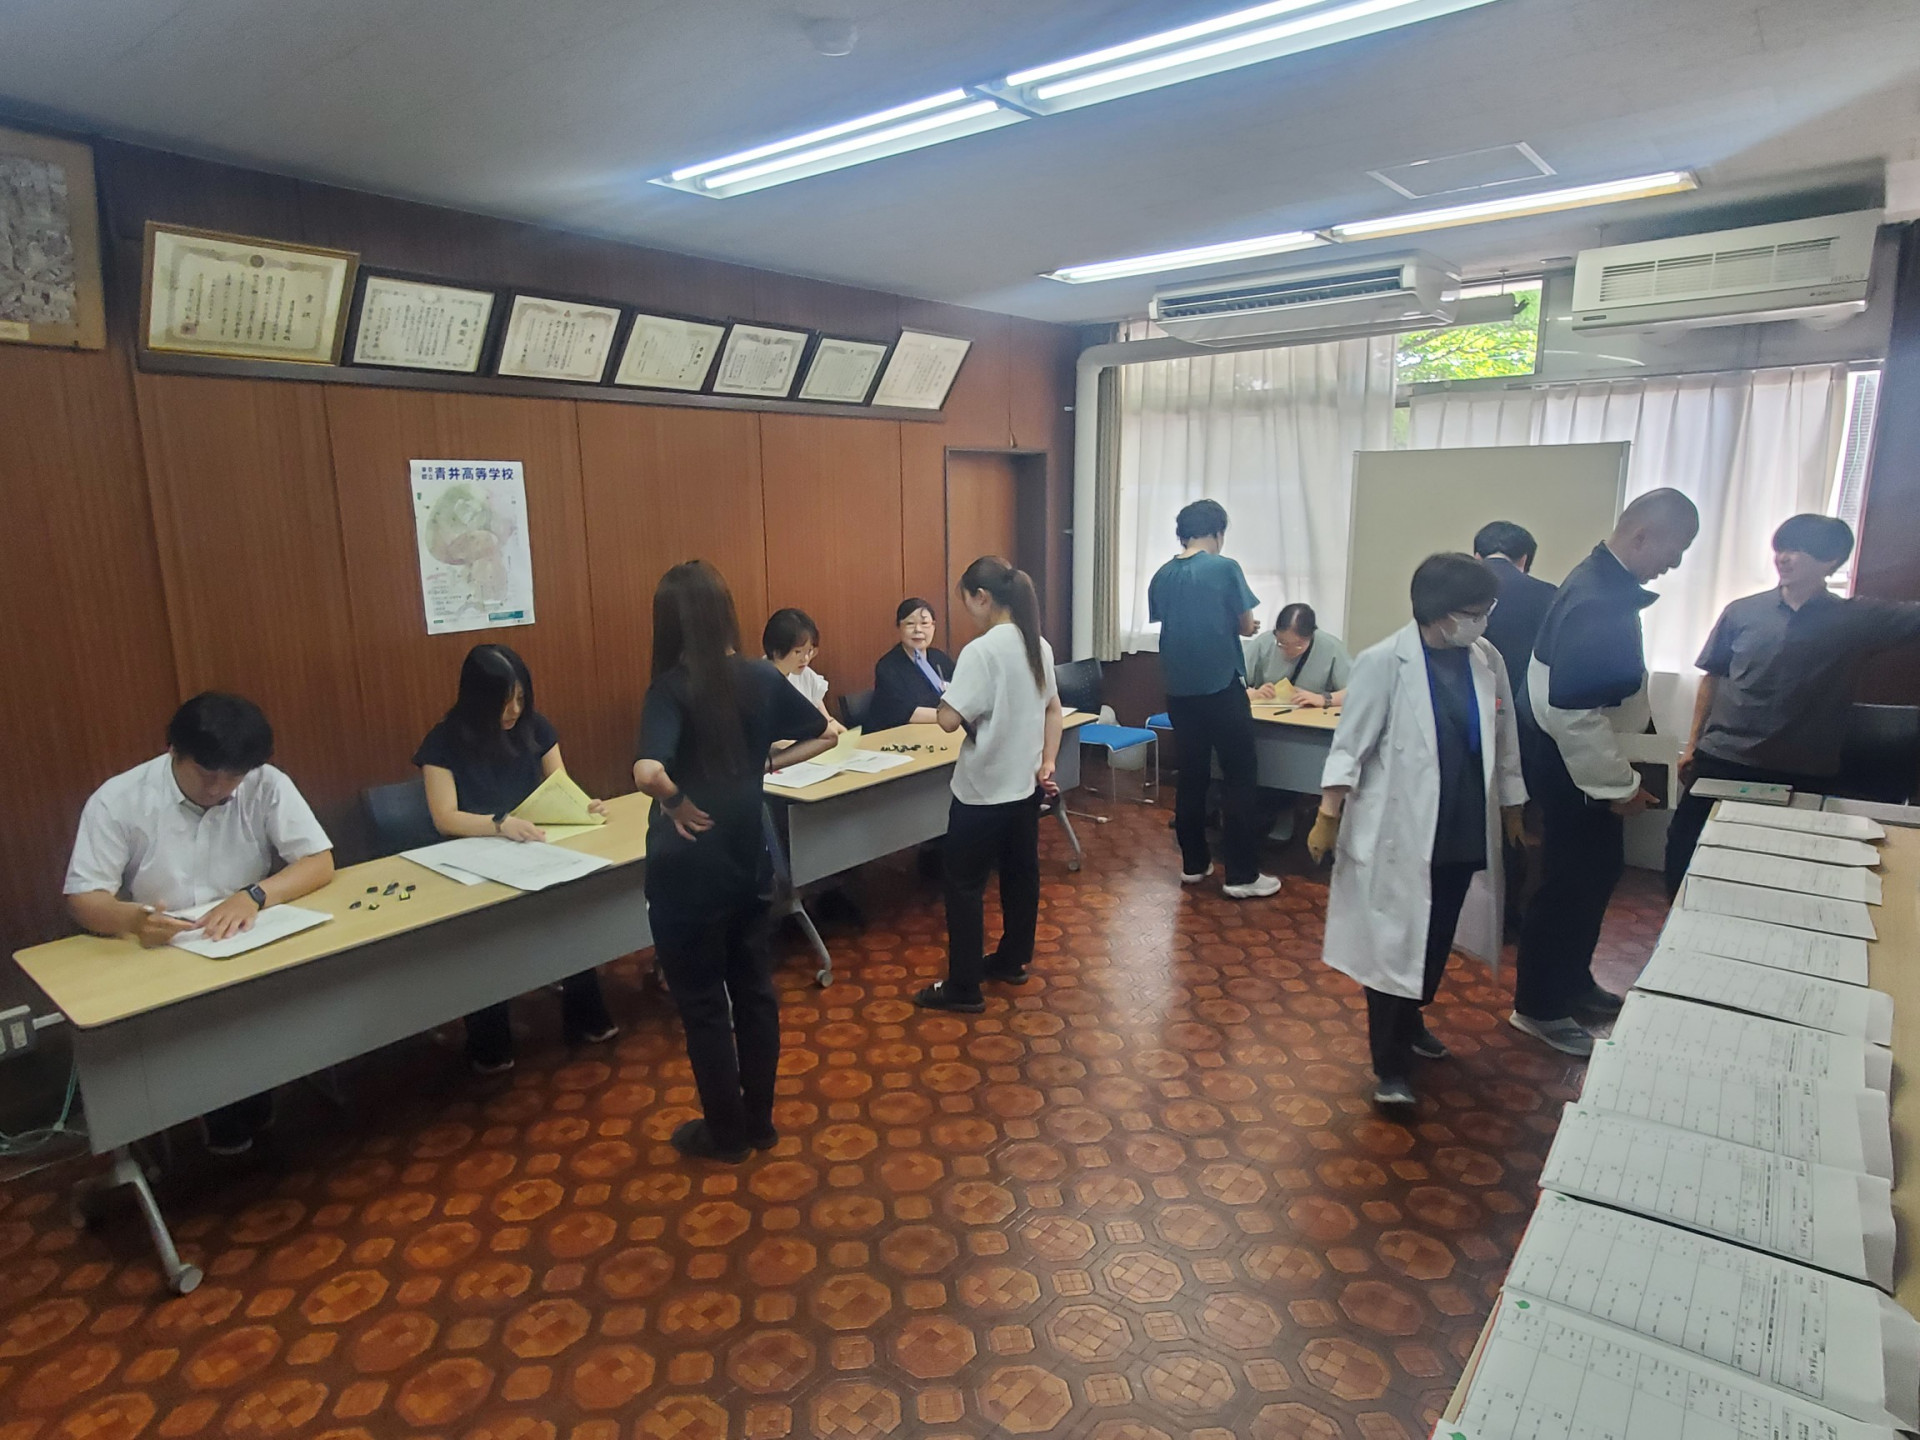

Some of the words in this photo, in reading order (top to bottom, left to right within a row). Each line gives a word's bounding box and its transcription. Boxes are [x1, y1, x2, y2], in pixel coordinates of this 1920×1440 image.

[435, 467, 514, 481] 青井高等学校
